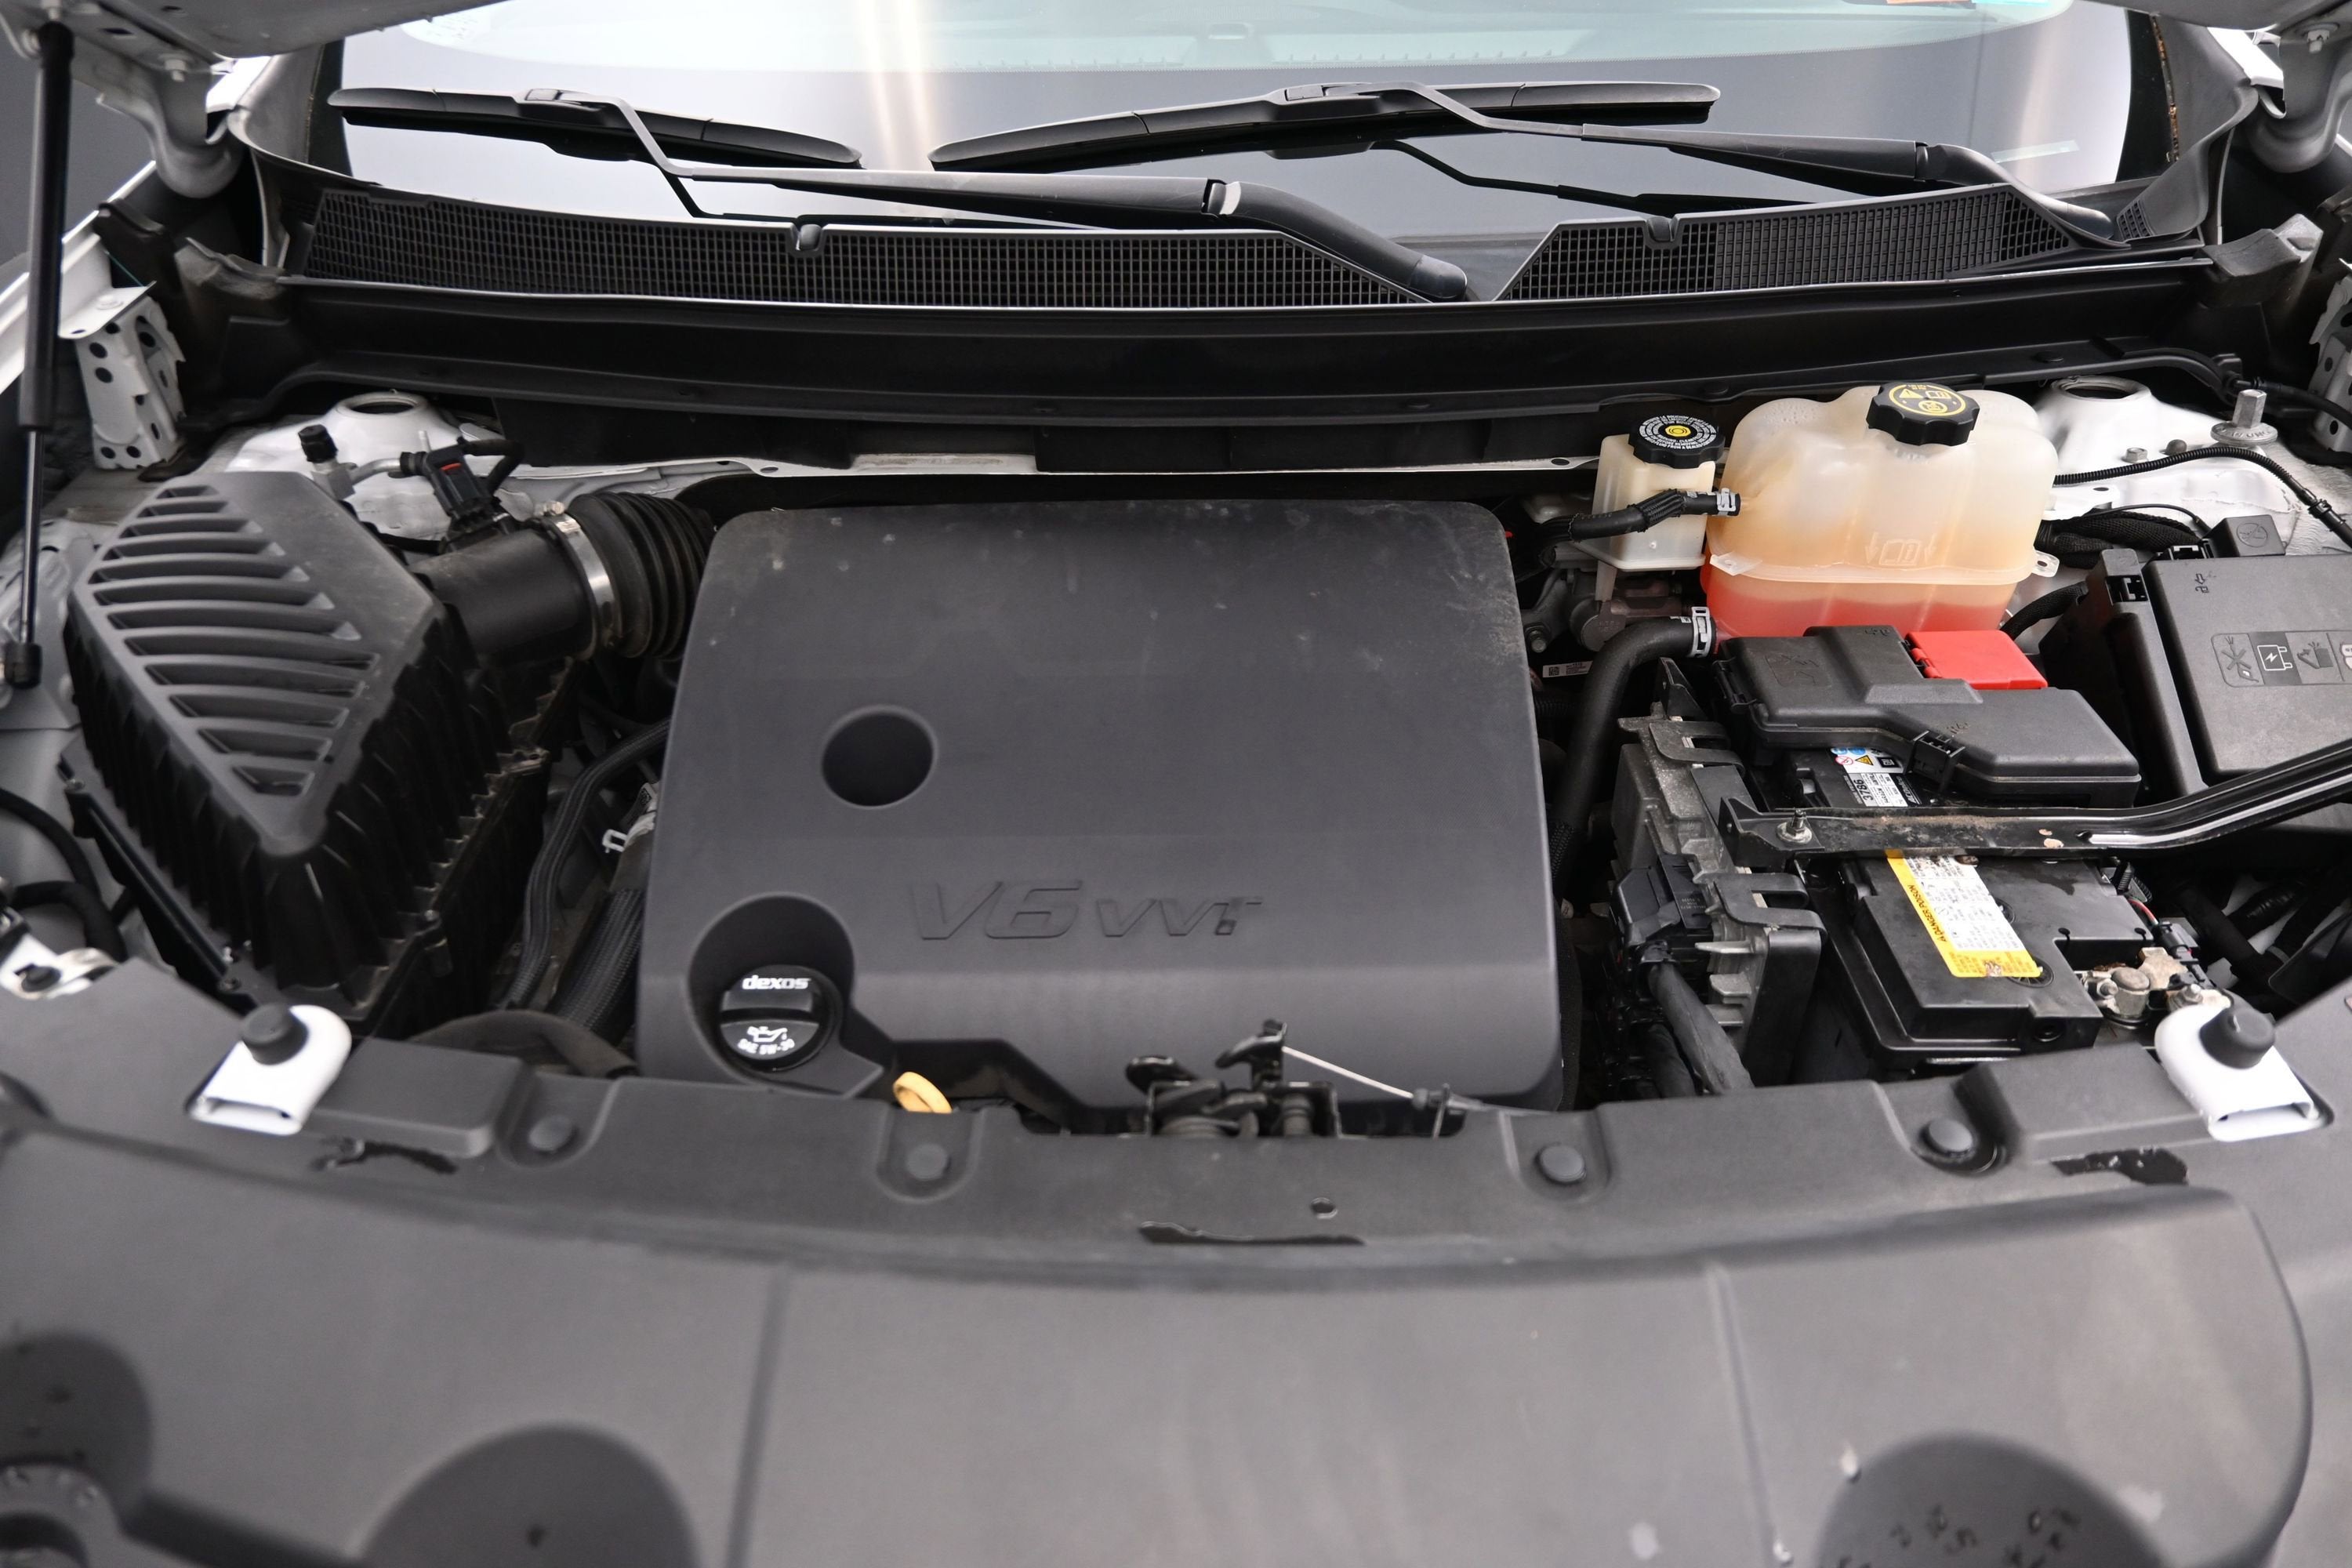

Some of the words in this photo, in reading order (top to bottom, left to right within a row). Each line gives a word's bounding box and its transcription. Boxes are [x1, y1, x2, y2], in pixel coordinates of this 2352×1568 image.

[1853, 779, 1875, 801] 3786
[1908, 884, 1926, 909] POISON
[909, 879, 1083, 940] V6
[1922, 906, 1945, 938] DANGER
[742, 975, 812, 989] dexos
